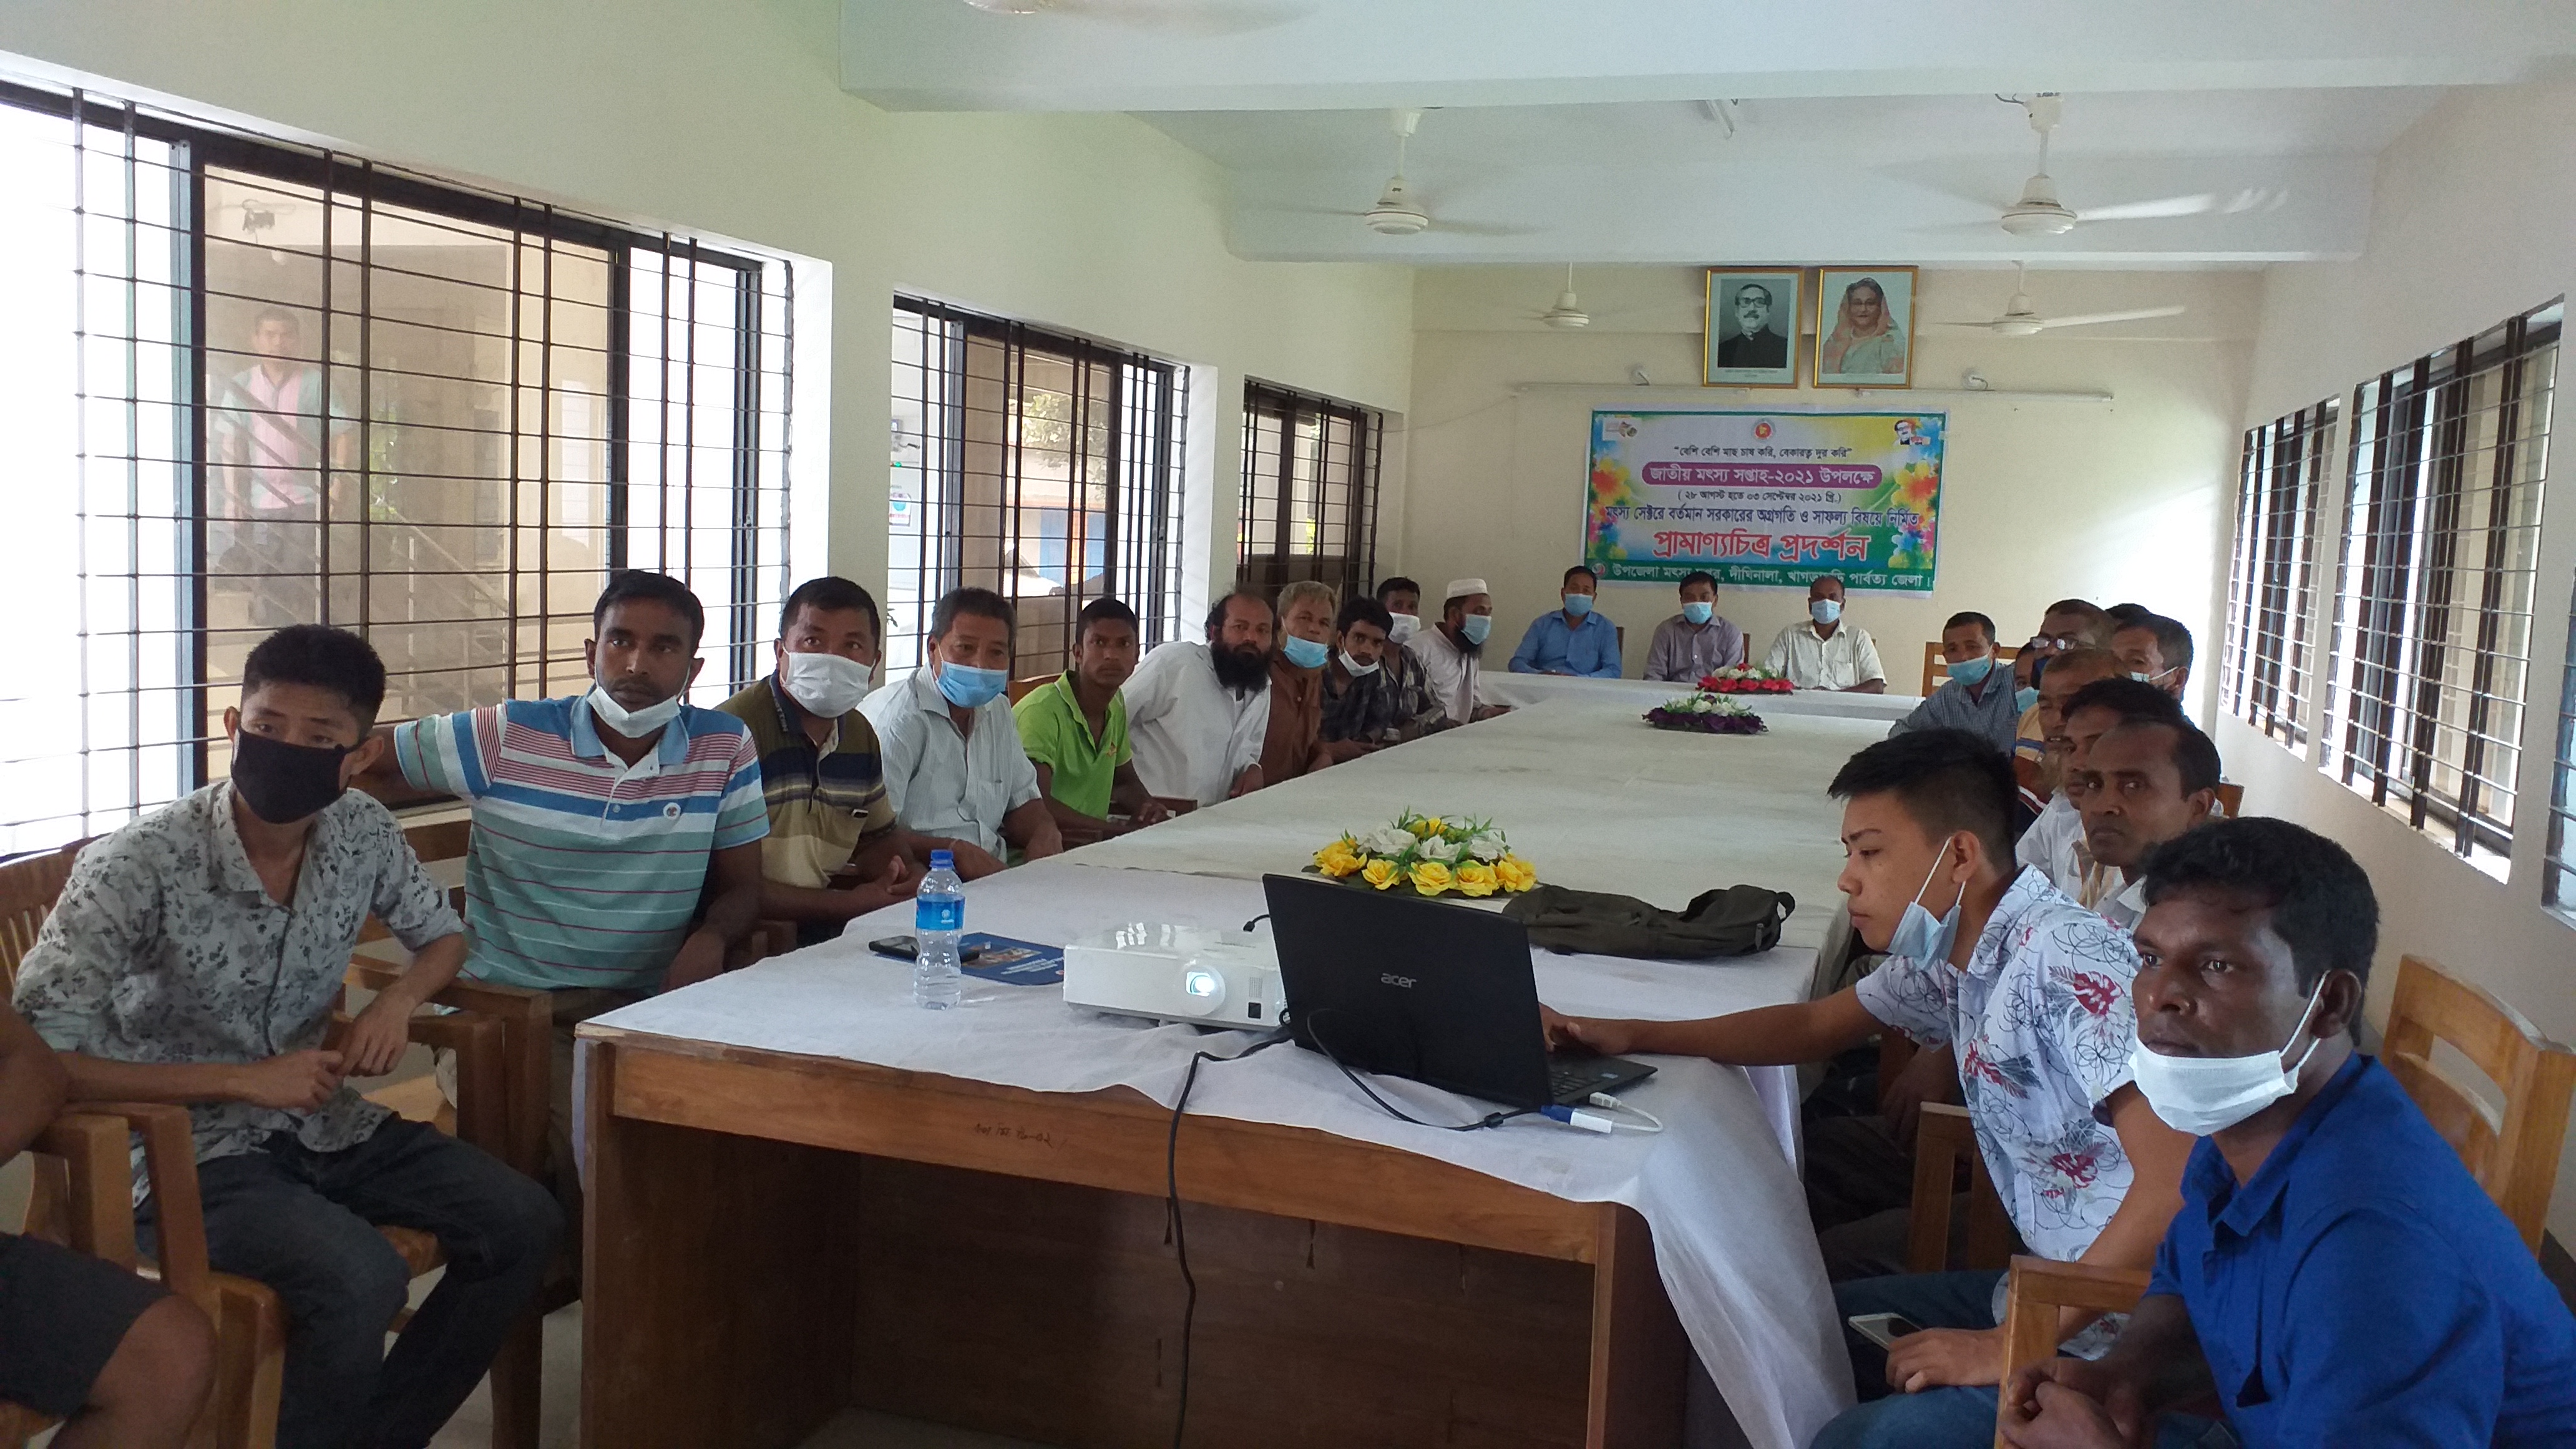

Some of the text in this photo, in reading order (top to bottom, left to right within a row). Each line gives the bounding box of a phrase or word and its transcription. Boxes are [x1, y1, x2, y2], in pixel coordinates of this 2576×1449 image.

[1701, 444, 1720, 456] বেশি
[1723, 447, 1738, 457] মাছ
[1649, 463, 1876, 485] জাতীয় মৎস্য সপ্তাহ-২০২১ উপলক্ষে
[1798, 492, 1822, 503] ২০২১
[1605, 502, 1920, 527] মৎস্য সেক্টরে বর্তমান সরকারের অগ্রগতি ও সাফল্য বিষয়ে নির্মিত
[1652, 527, 1871, 562] প্রামাণ্যচিত্র প্রদর্শন
[1612, 563, 1659, 578] উপজেলা
[1849, 570, 1888, 585] পার্বত্য
[1891, 573, 1923, 587] জেলা
[1381, 973, 1417, 988] acer
